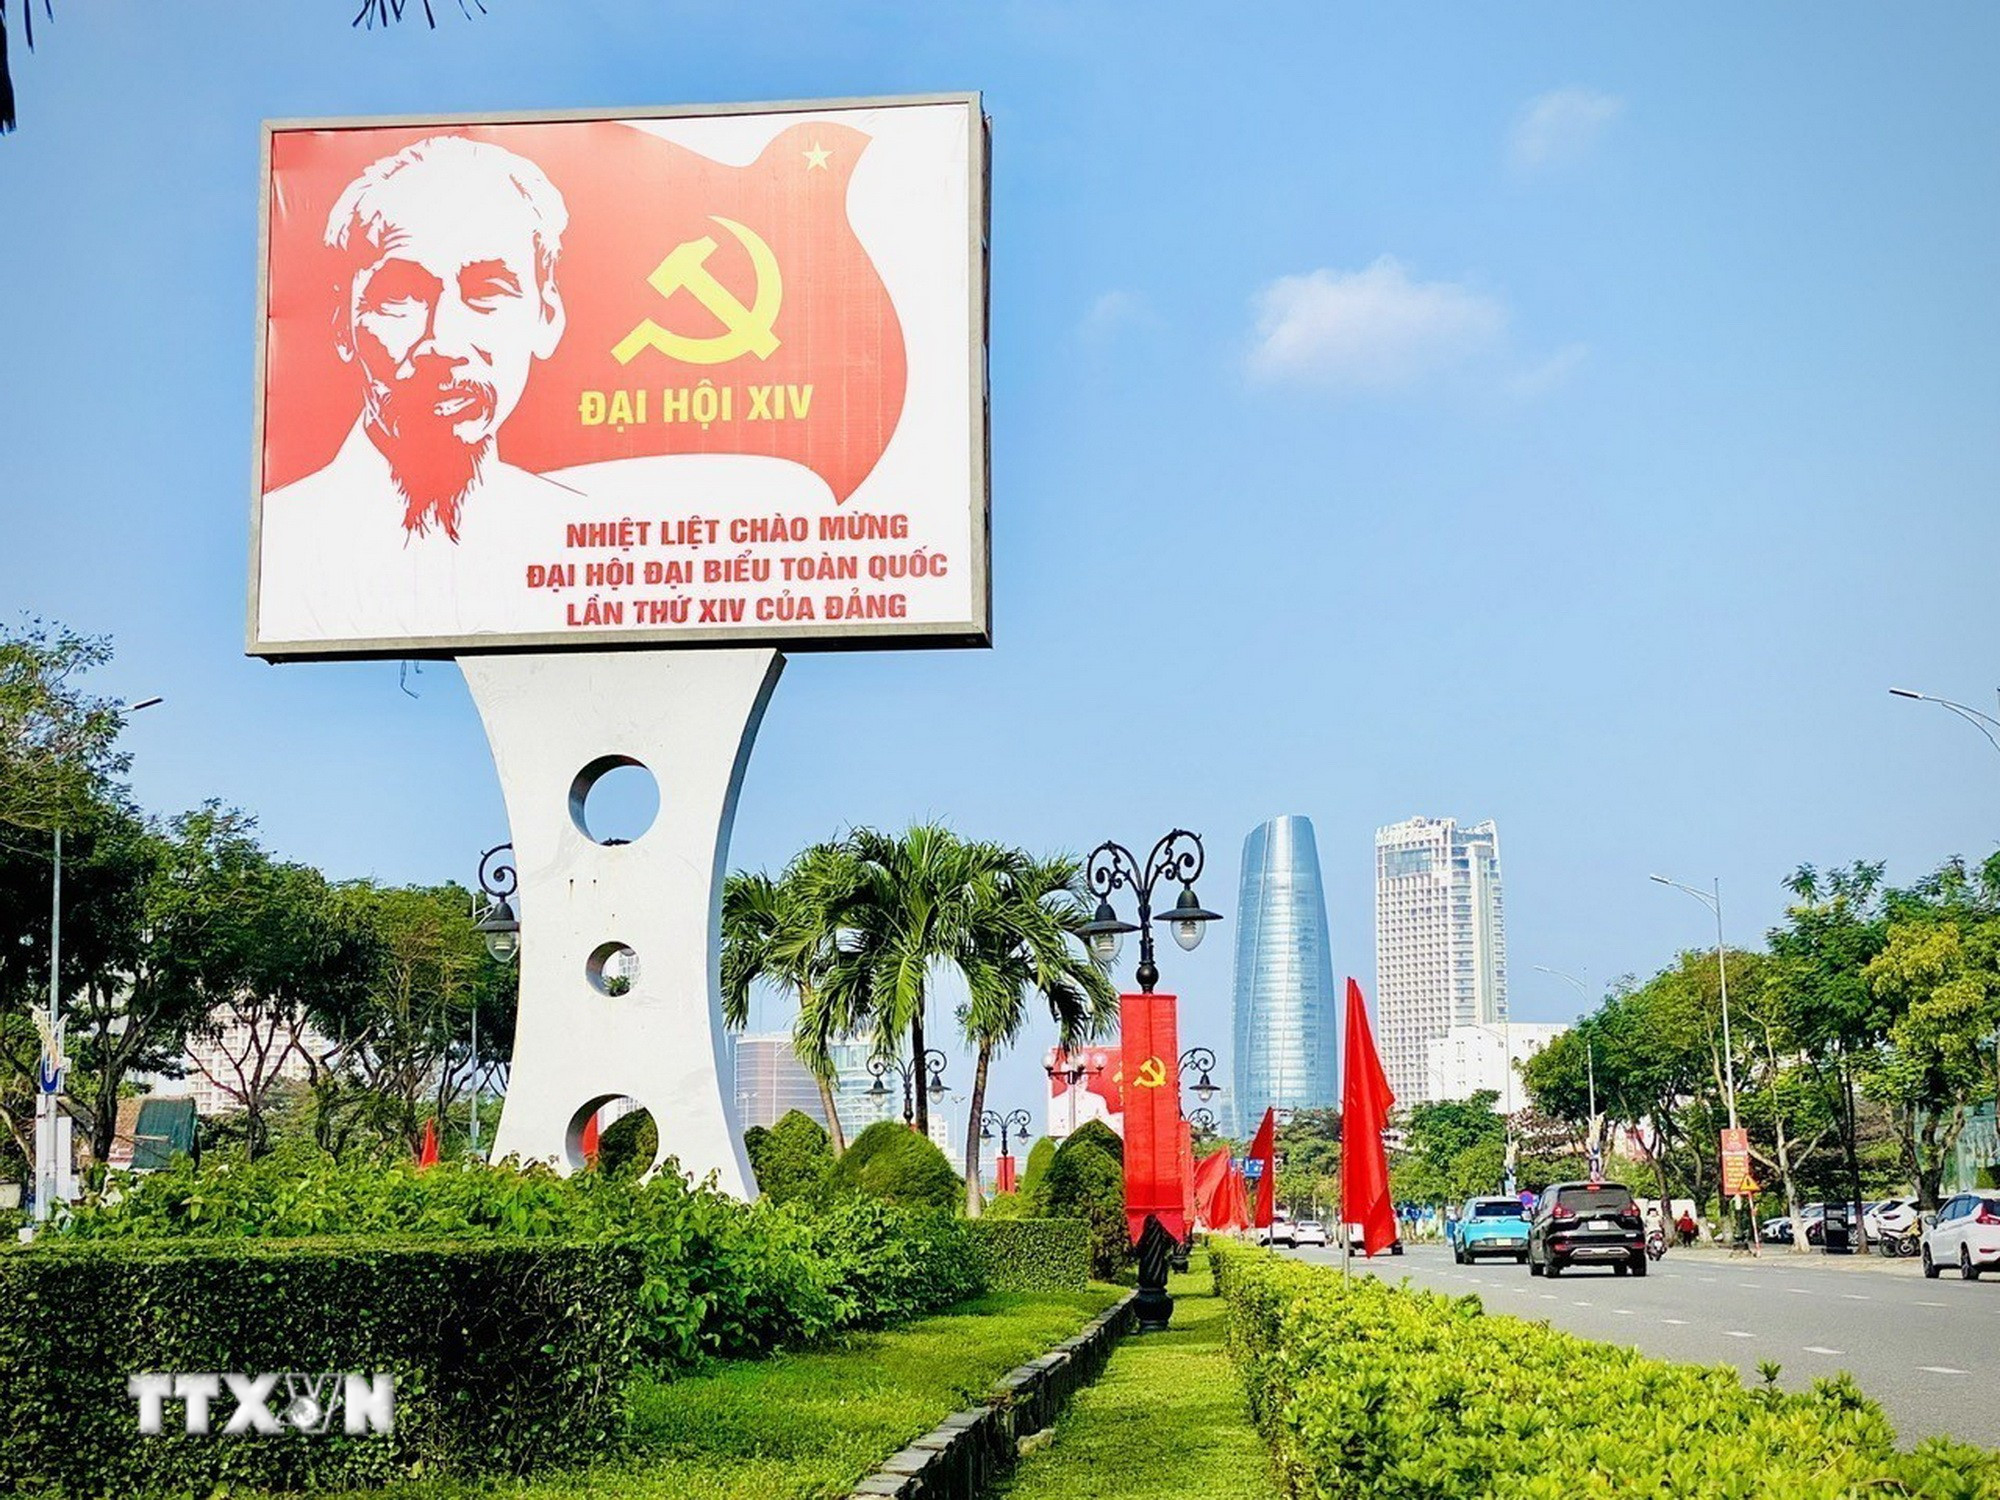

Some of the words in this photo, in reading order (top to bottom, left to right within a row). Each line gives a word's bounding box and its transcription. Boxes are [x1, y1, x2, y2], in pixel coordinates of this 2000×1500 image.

[578, 389, 647, 433] ĐẠI
[663, 378, 732, 430] HỘI
[747, 383, 814, 420] XIV
[566, 517, 651, 551] NHIỆT
[660, 515, 720, 549] LIỆT
[729, 513, 809, 543] CHÀO
[819, 511, 909, 540] MỪNG
[526, 564, 575, 593] ĐẠI
[585, 557, 635, 591] HỘI
[643, 560, 693, 589] ĐẠI
[703, 549, 770, 583] BIỂU
[780, 551, 858, 581] TOÀN
[868, 545, 948, 581] QUỐC
[566, 594, 623, 626] LẦN
[633, 594, 692, 624] THỨ
[698, 598, 746, 623] XIV
[756, 589, 815, 621] CỦA
[824, 587, 907, 620] ĐẢNG
